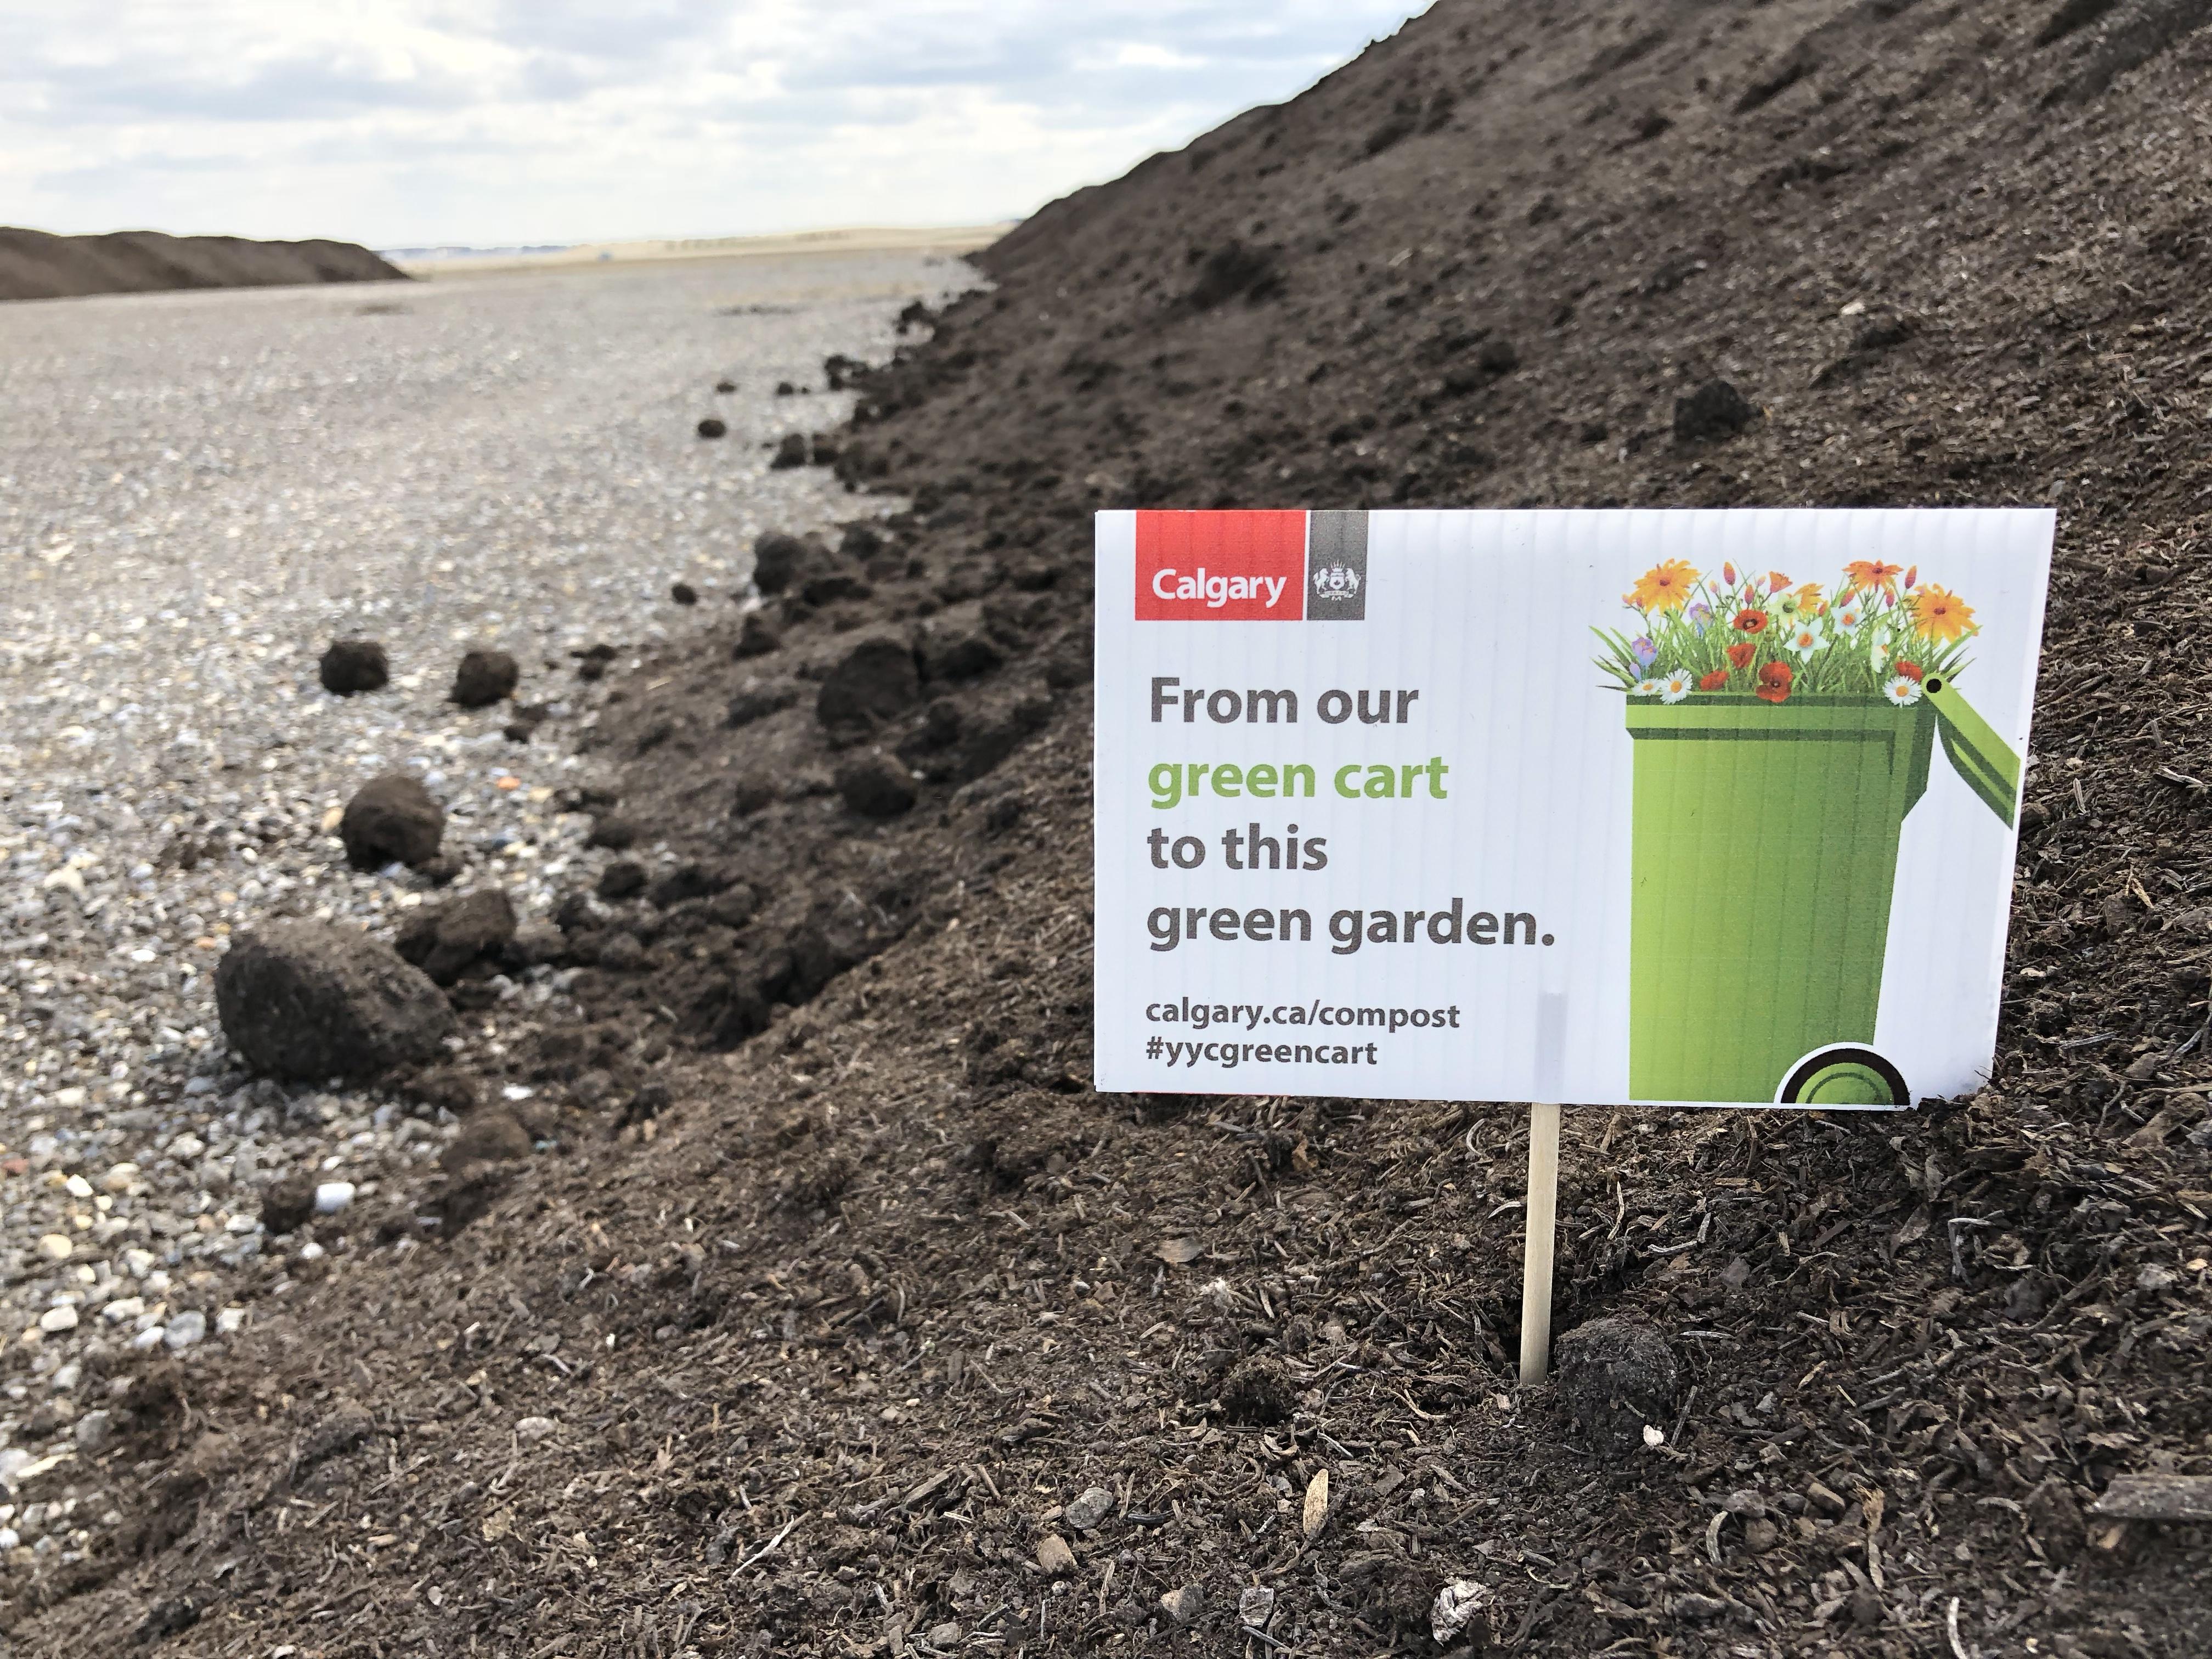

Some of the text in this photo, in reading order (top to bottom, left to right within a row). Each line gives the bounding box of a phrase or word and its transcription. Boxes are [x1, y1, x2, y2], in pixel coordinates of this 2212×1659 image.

[1152, 567, 1288, 608] Calgary
[1151, 677, 1419, 724] From our
[1148, 757, 1449, 809] green cart
[1147, 823, 1328, 871] to this
[1147, 898, 1555, 955] green garden.
[1146, 996, 1460, 1034] calgary.ca/compost
[1146, 1036, 1378, 1069] #yycgreencart
